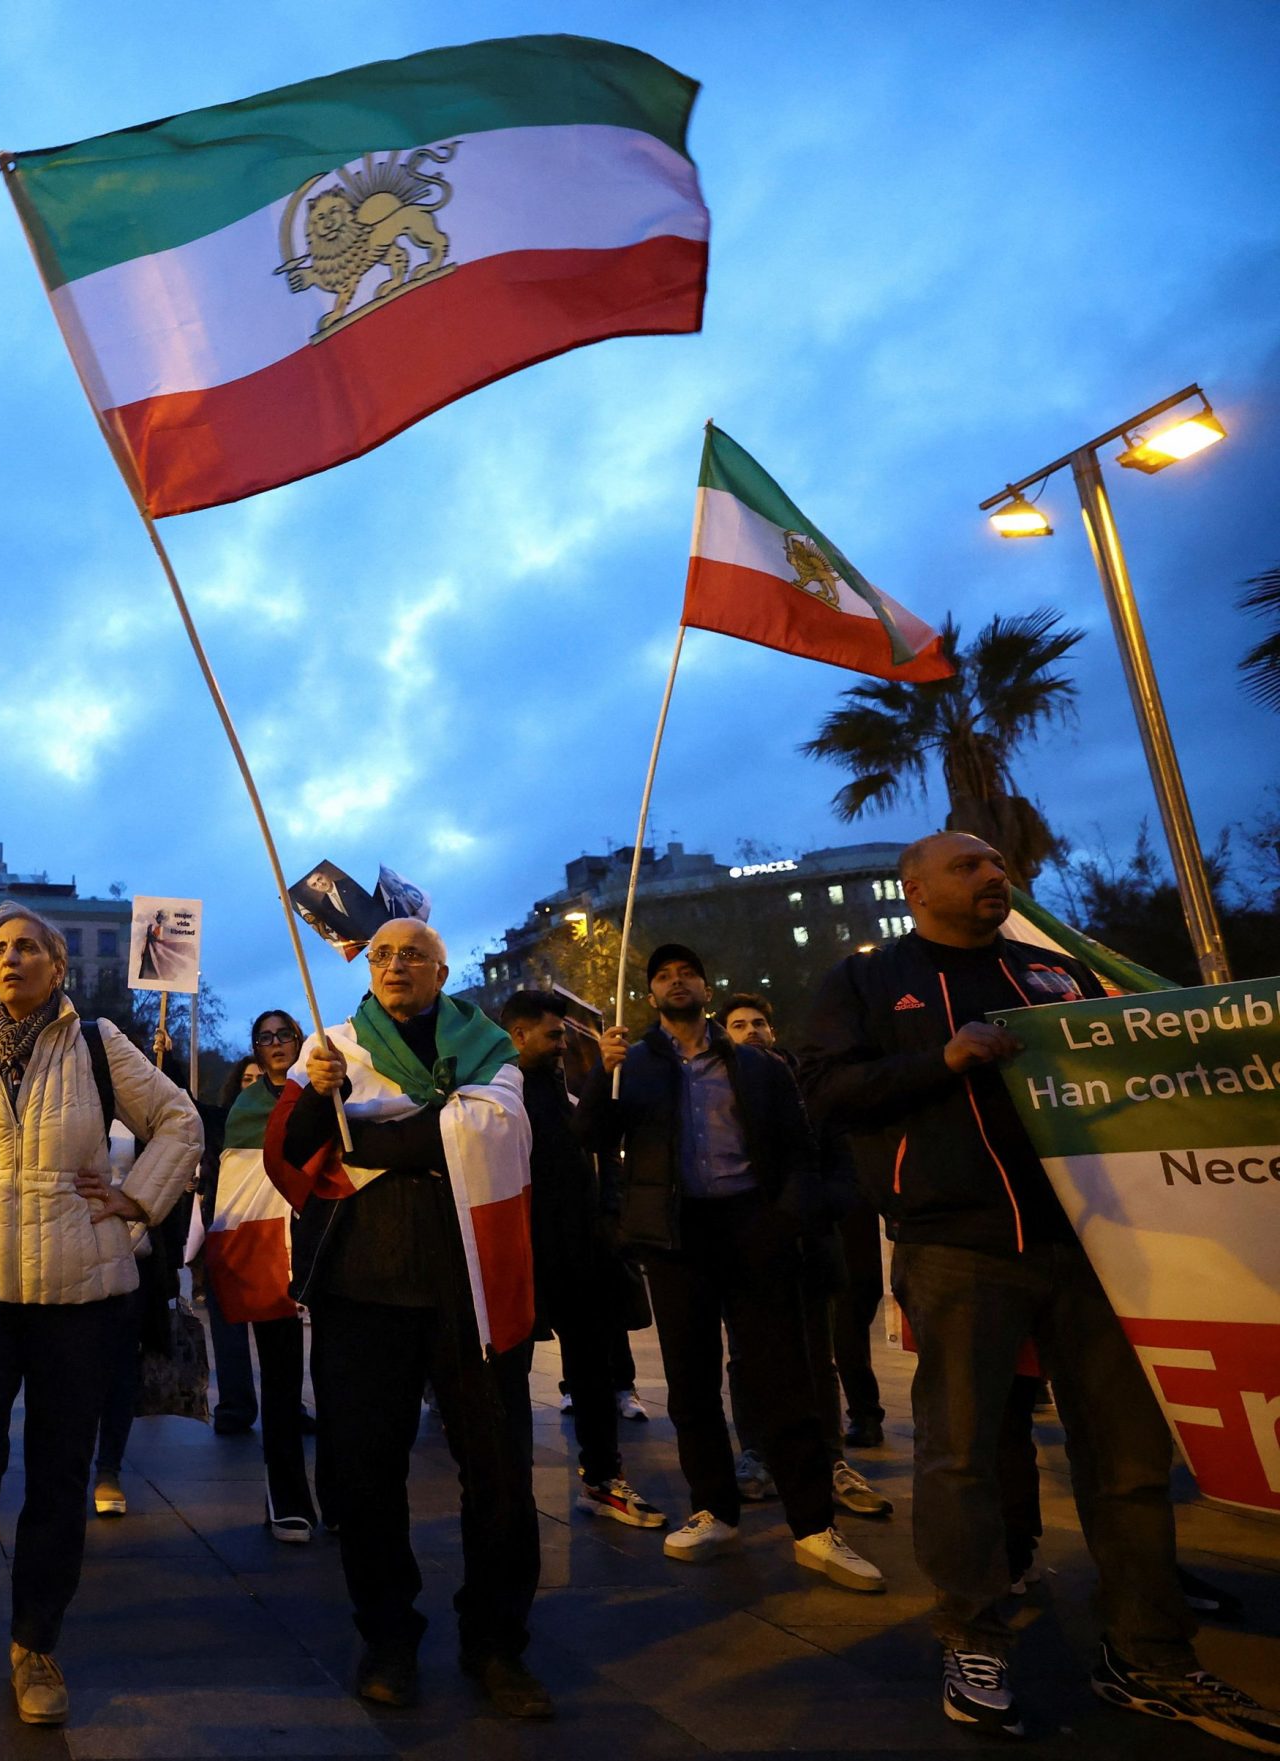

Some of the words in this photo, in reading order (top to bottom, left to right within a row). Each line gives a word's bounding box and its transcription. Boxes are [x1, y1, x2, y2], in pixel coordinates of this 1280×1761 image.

[170, 928, 195, 936] libertad
[1059, 1018, 1115, 1050] La
[1027, 1076, 1111, 1110] Han
